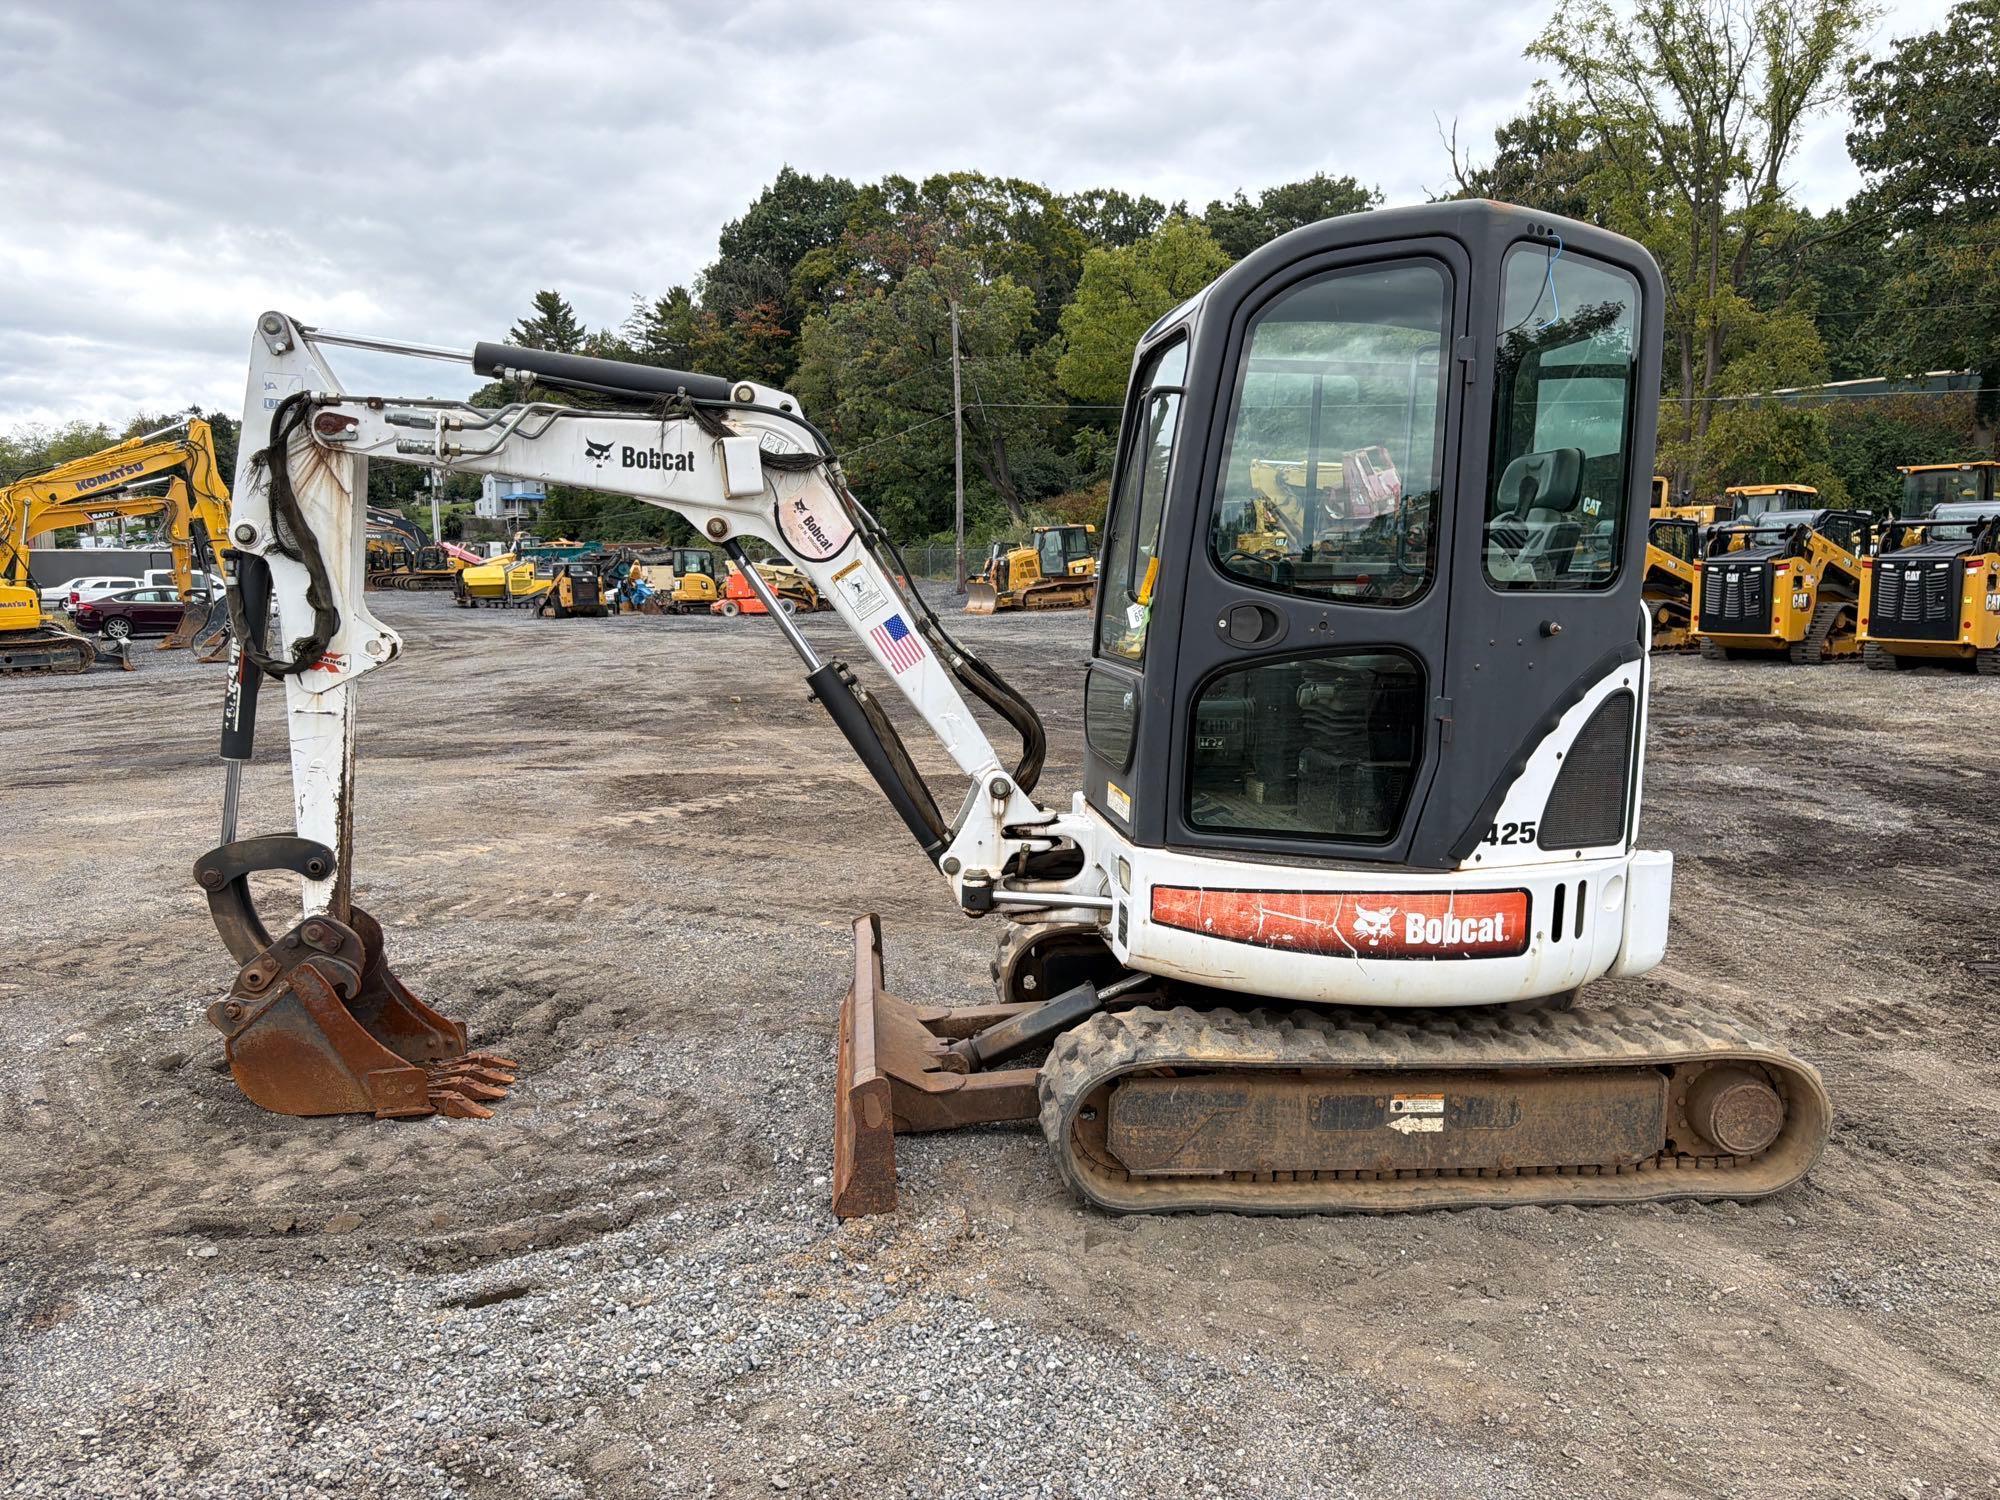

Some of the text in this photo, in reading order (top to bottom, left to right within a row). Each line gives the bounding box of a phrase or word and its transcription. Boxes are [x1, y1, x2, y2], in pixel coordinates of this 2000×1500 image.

[622, 446, 695, 472] Bobcat
[75, 461, 145, 492] KOMATSU
[91, 511, 115, 519] SANY
[1582, 496, 1602, 517] CAT
[802, 515, 833, 551] Bobcat
[1726, 573, 1740, 582] CAT
[1905, 570, 1921, 581] CAT
[1792, 593, 1808, 608] CAT
[1481, 821, 1537, 846] 425
[1405, 912, 1505, 945] Bobcat
